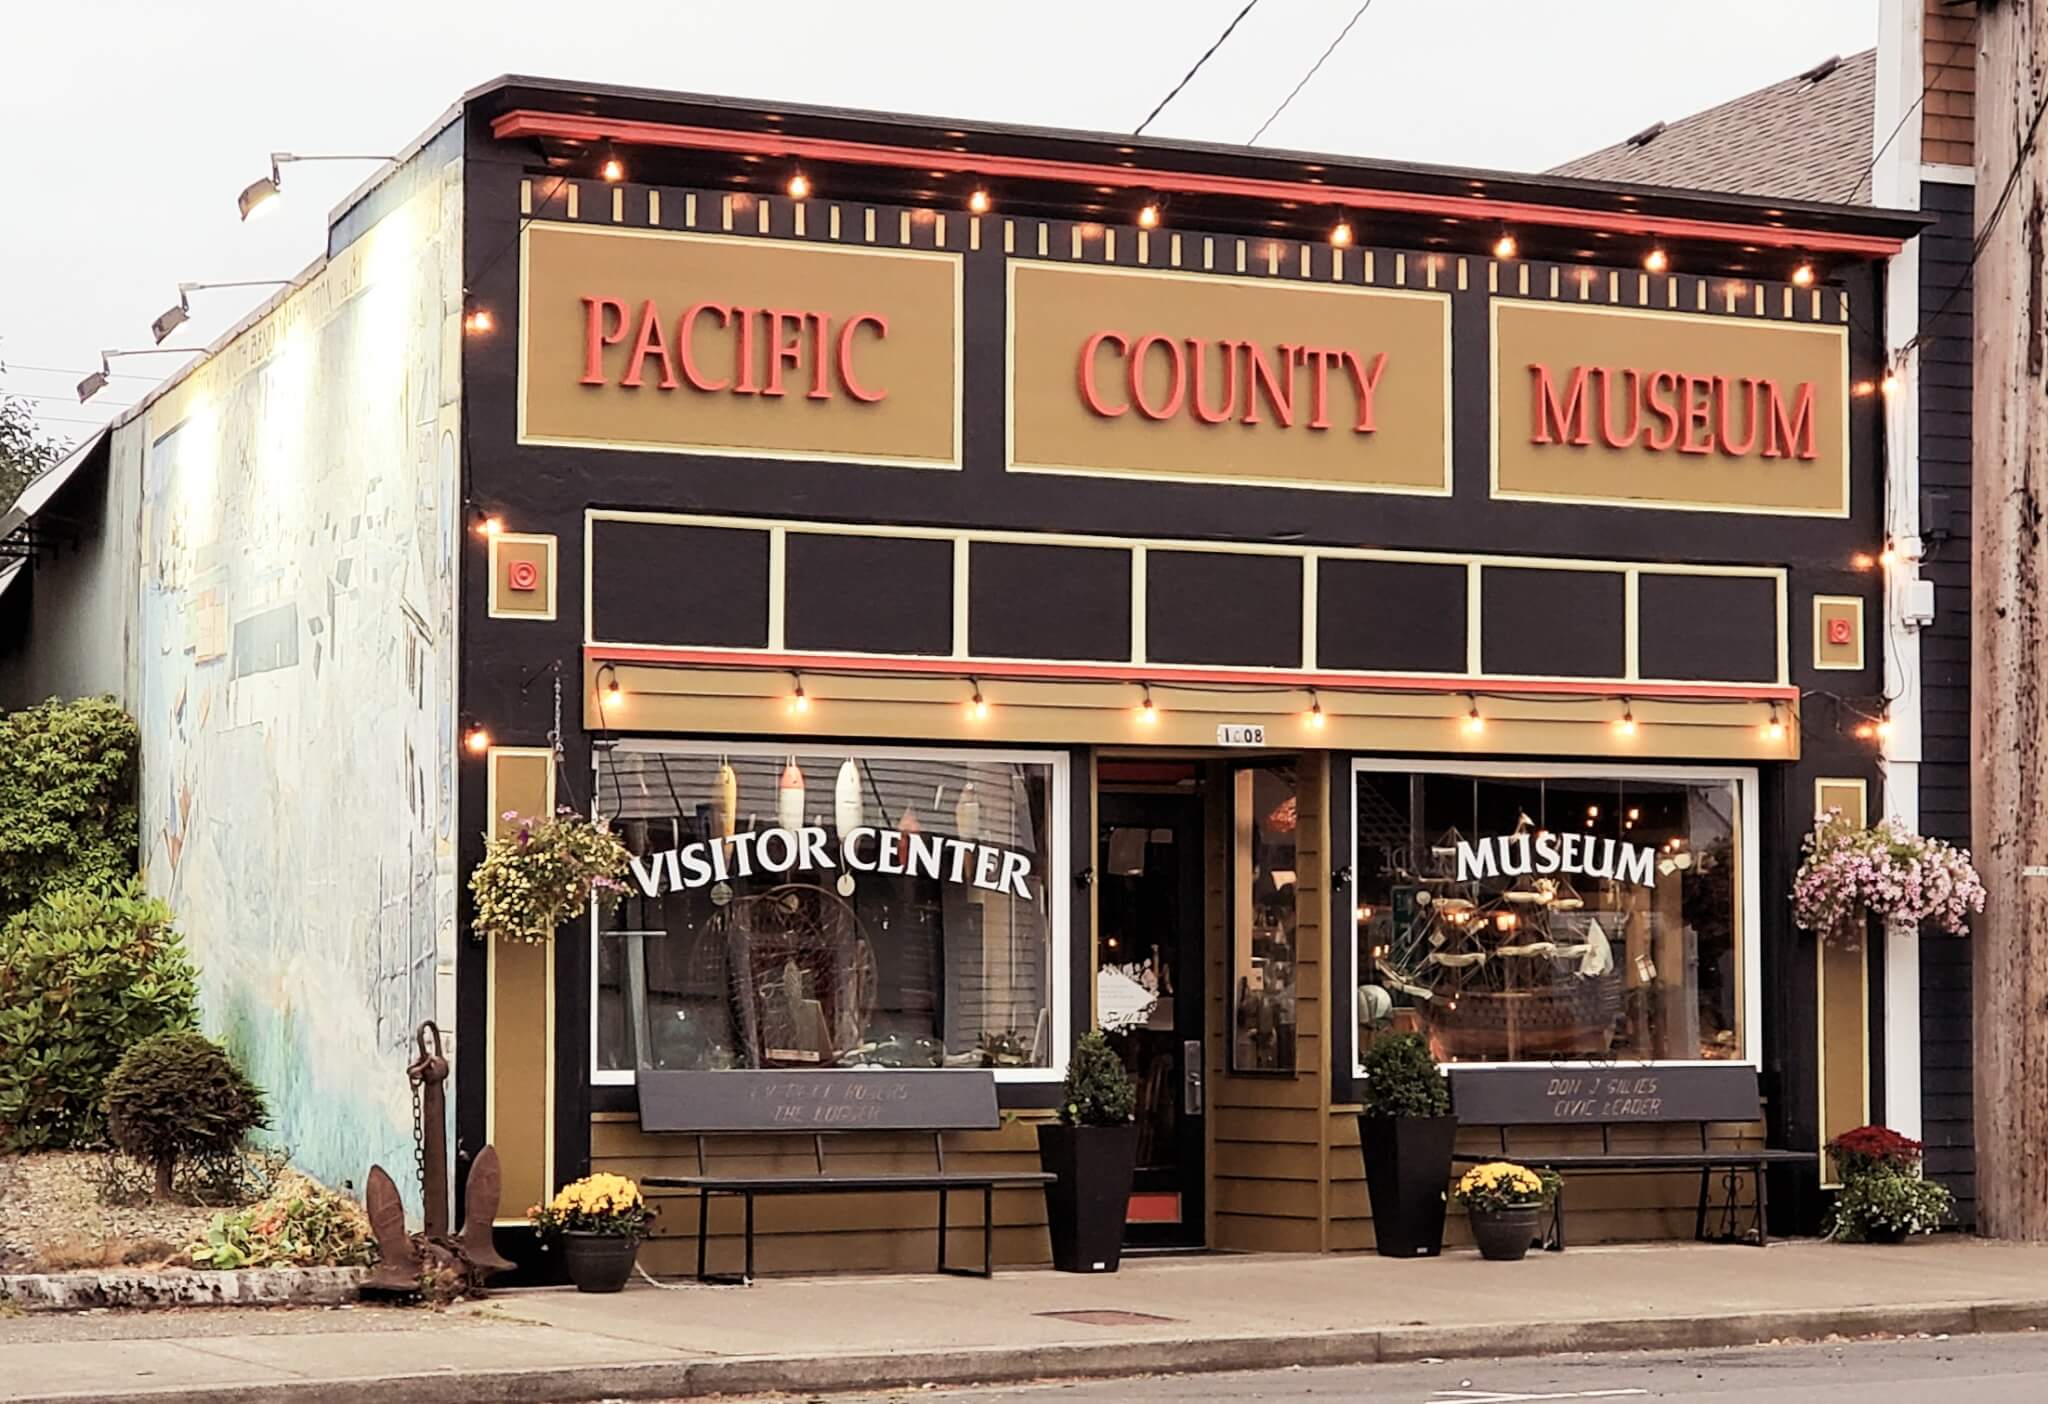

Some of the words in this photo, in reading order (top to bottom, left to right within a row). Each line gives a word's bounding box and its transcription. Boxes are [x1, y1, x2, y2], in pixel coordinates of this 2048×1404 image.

[580, 295, 890, 403] PACIFIC
[1078, 329, 1389, 434] COUNTY
[1528, 362, 1820, 461] MUSEUM
[629, 826, 836, 898] VISITOR
[843, 826, 1033, 900] CENTER
[1456, 833, 1656, 888] MUSEUM
[1554, 1099, 1597, 1117] CIVIC
[1601, 1098, 1662, 1116] LEADER
